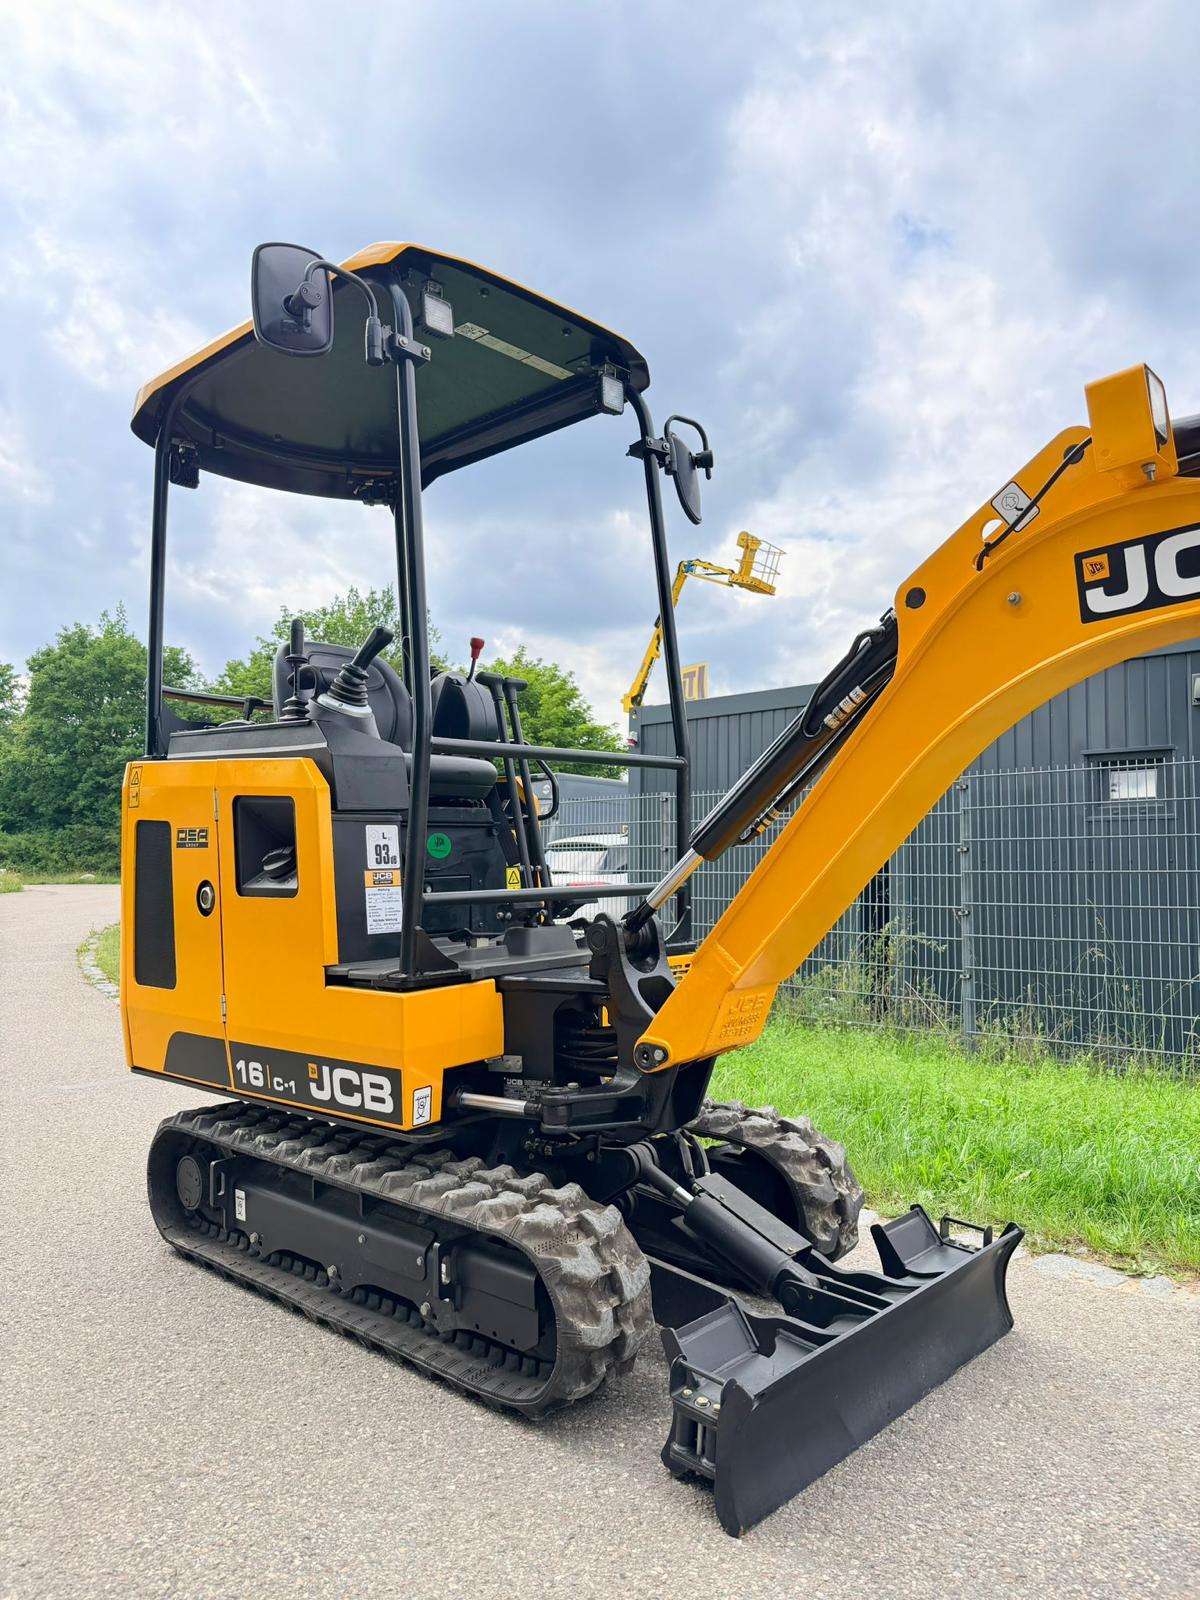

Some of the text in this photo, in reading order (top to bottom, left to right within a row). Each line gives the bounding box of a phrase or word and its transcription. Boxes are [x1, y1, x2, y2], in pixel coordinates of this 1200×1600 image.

[1088, 562, 1105, 575] JCB
[375, 844, 390, 864] 93
[373, 872, 393, 880] JCB
[236, 1060, 264, 1087] 16
[309, 1065, 394, 1114] JCB
